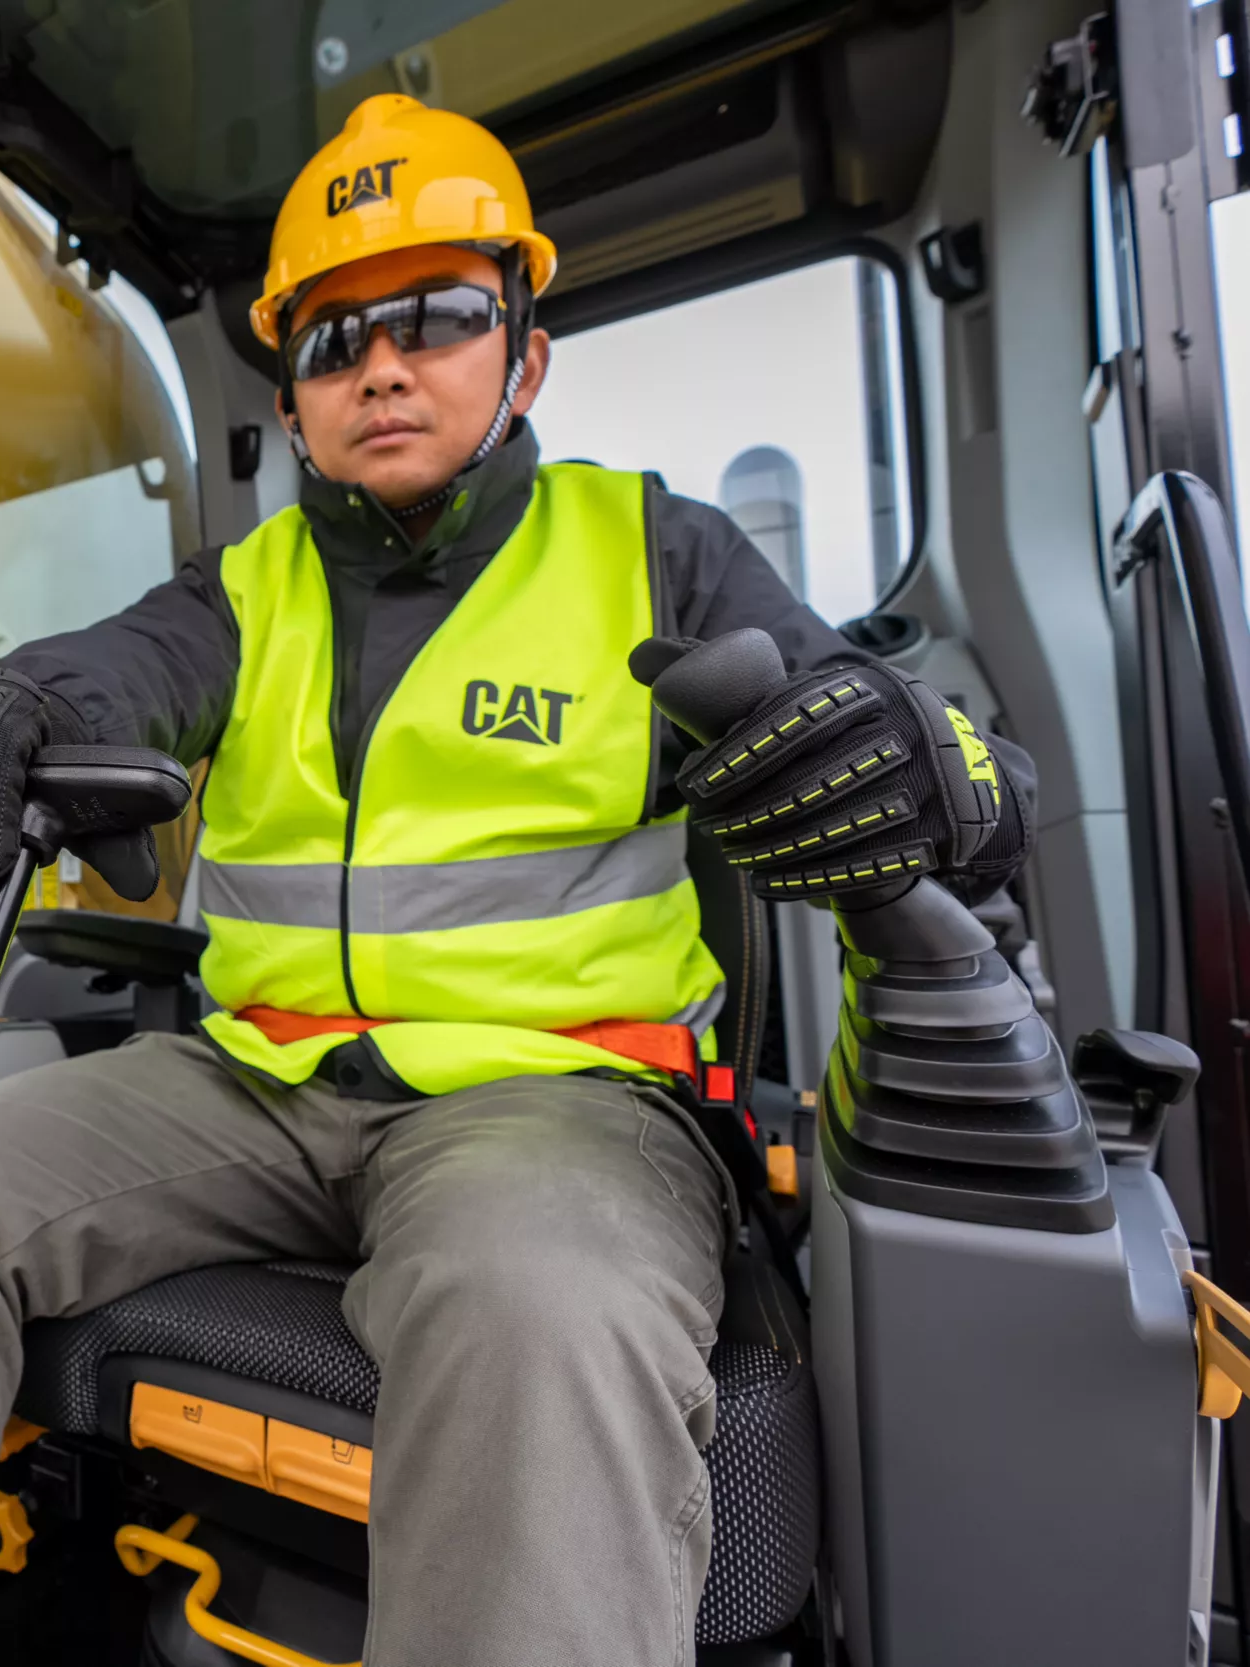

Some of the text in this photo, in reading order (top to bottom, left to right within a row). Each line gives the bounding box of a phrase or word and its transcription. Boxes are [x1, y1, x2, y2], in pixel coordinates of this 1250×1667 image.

[327, 158, 400, 218] CAT
[462, 679, 573, 745] CAT
[945, 706, 998, 788] CAT
